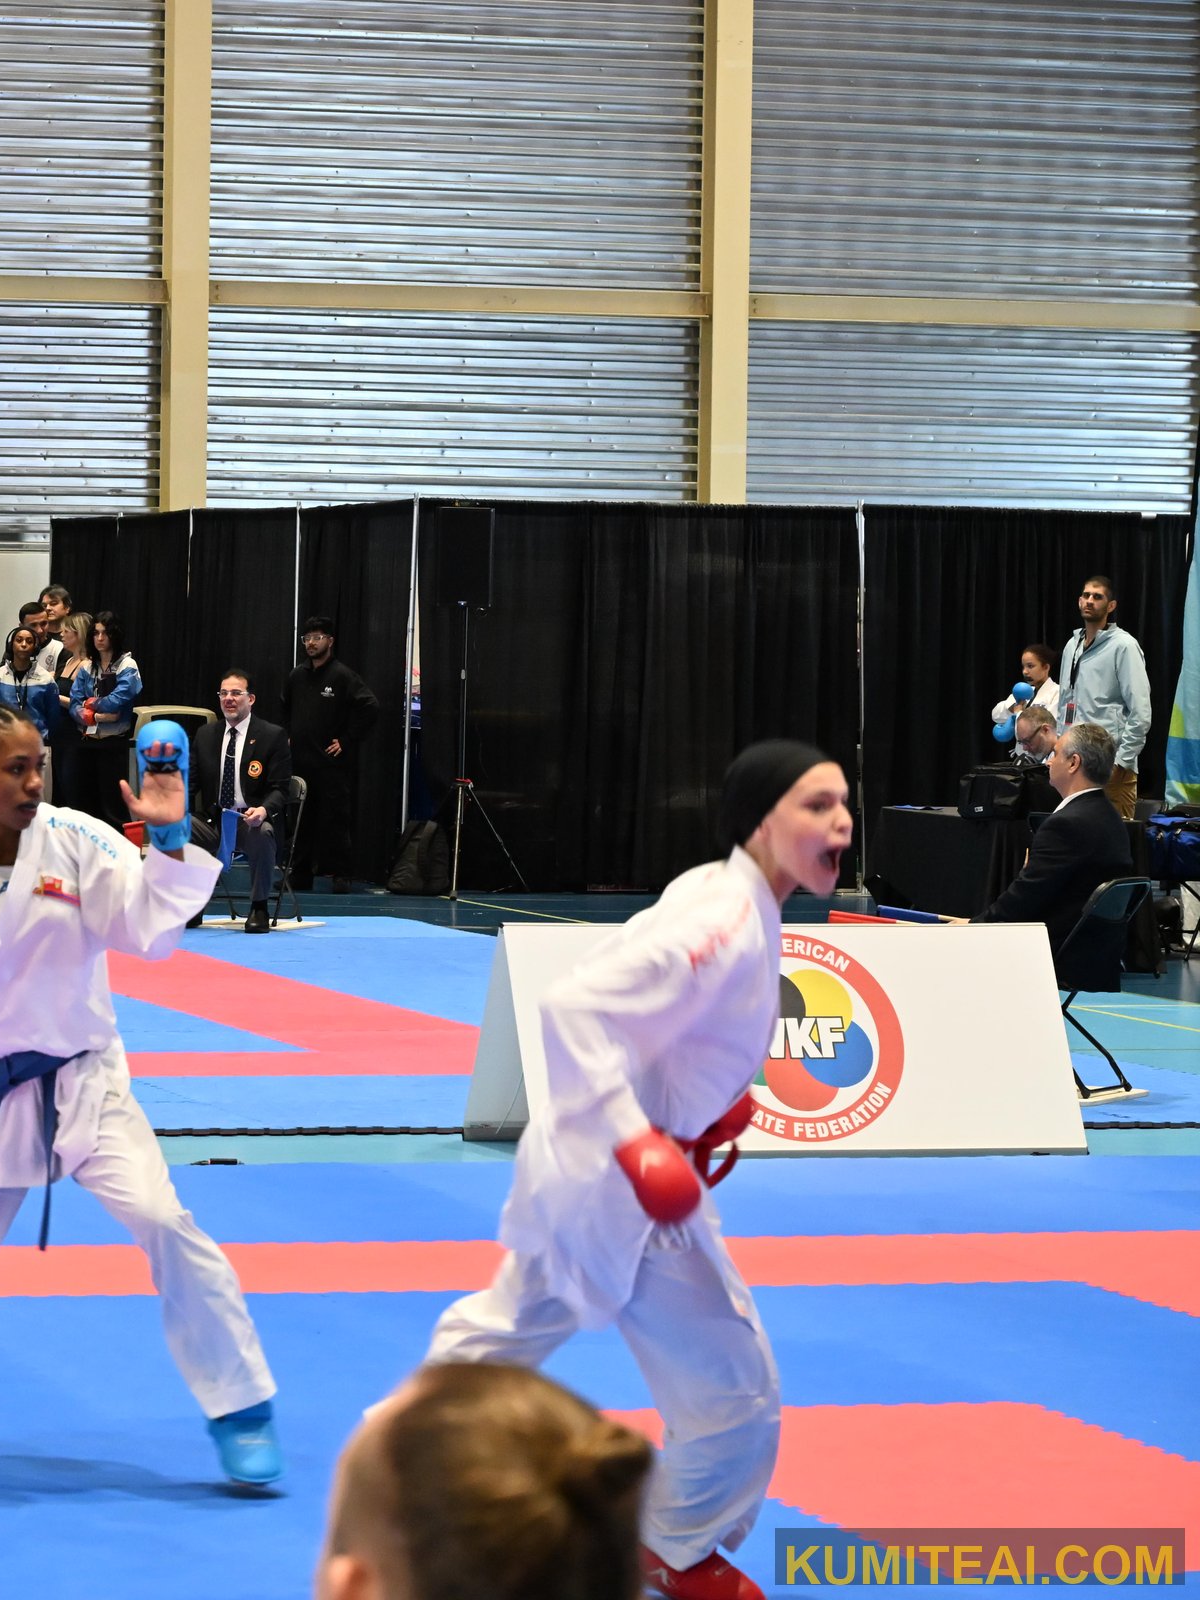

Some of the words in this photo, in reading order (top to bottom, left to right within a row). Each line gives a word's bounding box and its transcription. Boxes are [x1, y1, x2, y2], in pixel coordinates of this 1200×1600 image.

[781, 938, 850, 973] ERICAN
[751, 1109, 786, 1135] ATE
[793, 1081, 893, 1139] FEDERATION
